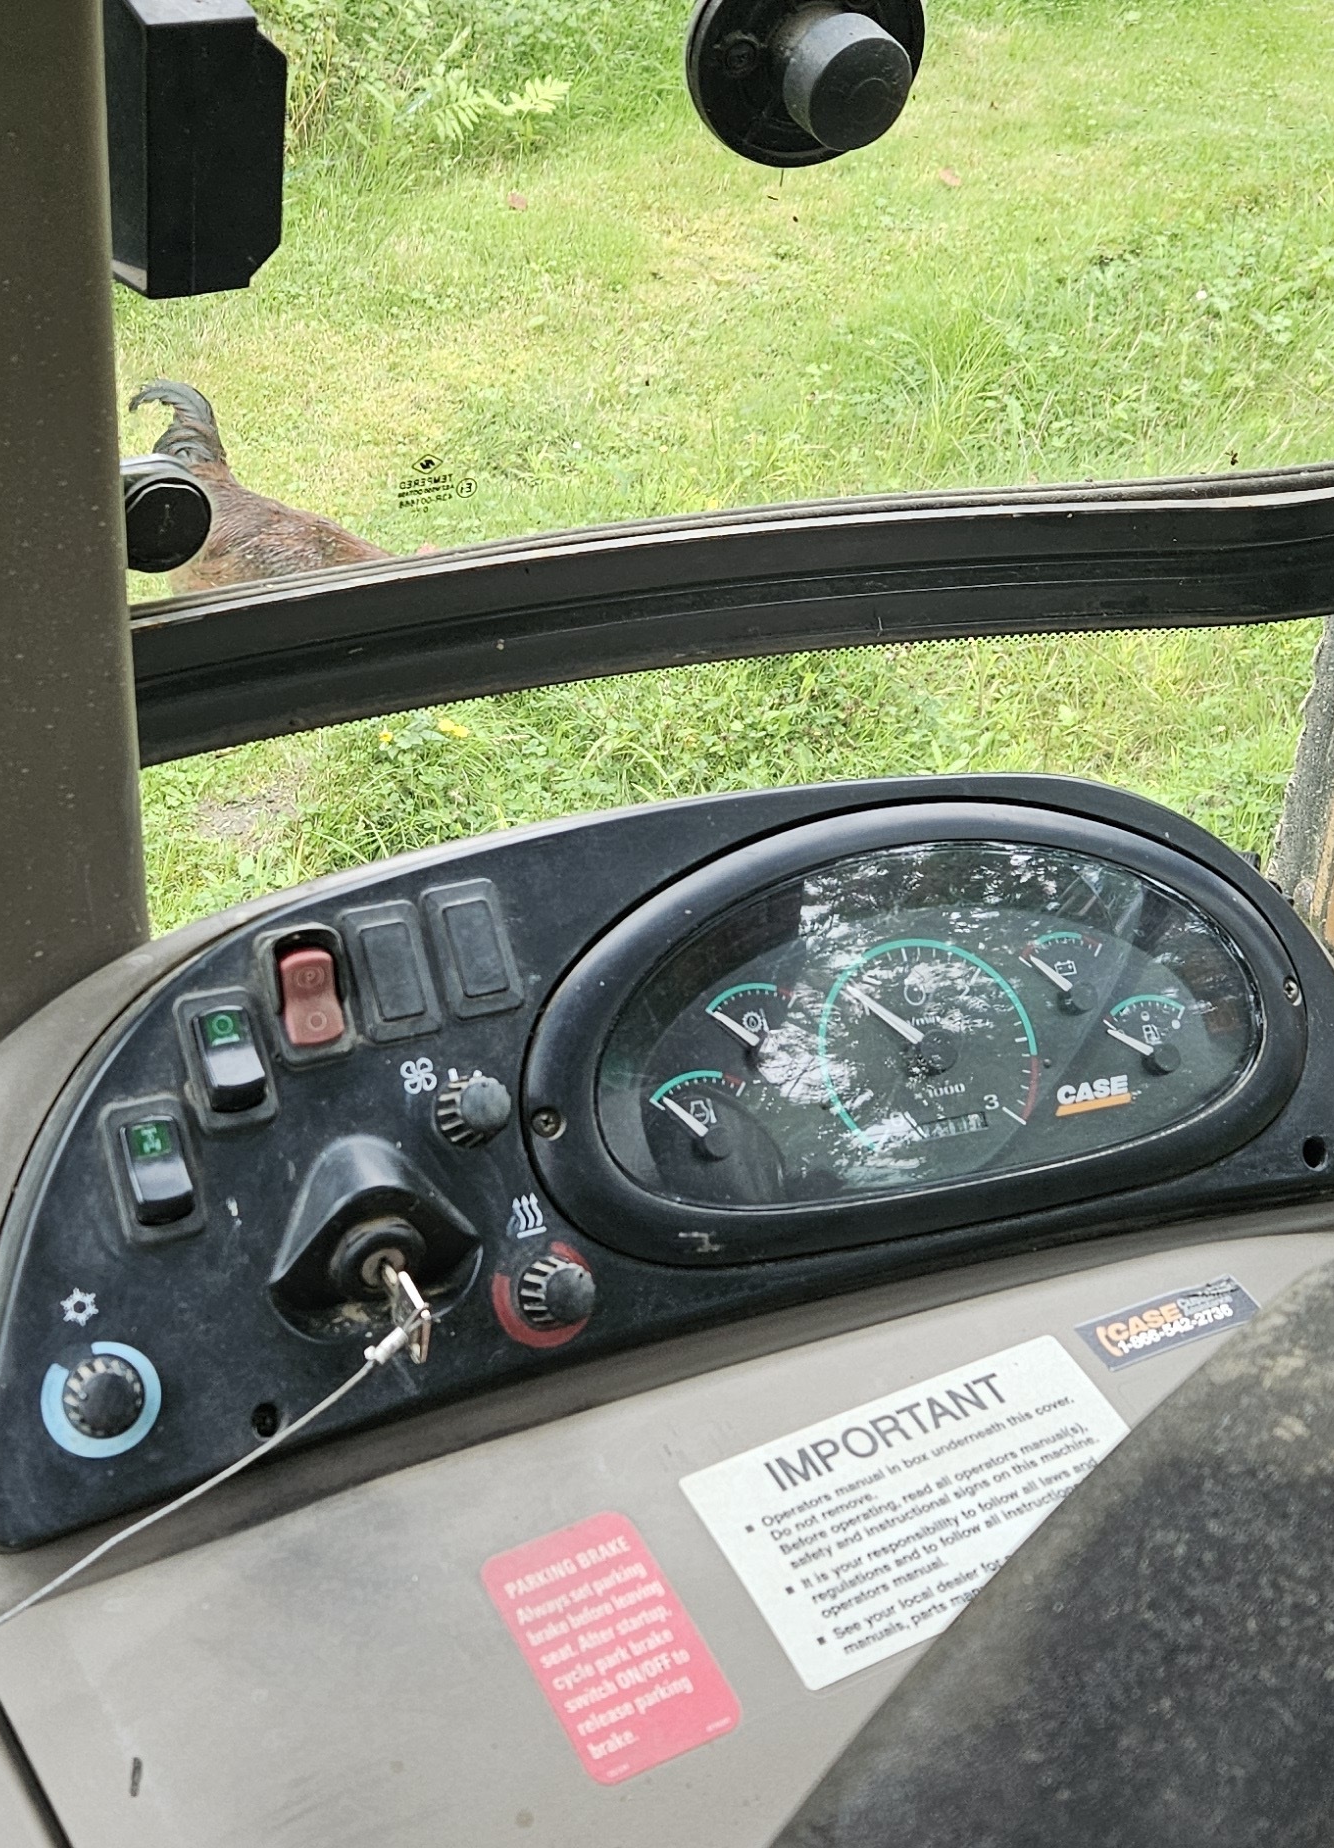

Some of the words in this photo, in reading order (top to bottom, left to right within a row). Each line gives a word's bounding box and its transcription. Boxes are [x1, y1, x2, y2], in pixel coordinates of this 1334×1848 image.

[926, 1083, 965, 1098] 1000
[983, 1093, 1000, 1110] 3
[1057, 1074, 1128, 1105] CASE
[1107, 1302, 1183, 1341] CASE
[762, 1493, 832, 1526] Operators
[835, 1469, 885, 1496] manual
[886, 1463, 901, 1475] in
[902, 1451, 929, 1469] box
[931, 1421, 1006, 1457] underneath
[1006, 1411, 1033, 1427] this
[1035, 1396, 1075, 1416] cover.
[764, 1372, 1006, 1491] IMPORTANT
[770, 1527, 792, 1541] Do
[795, 1515, 818, 1531] not
[822, 1493, 878, 1520] remove.
[779, 1529, 827, 1555] Before
[902, 1483, 932, 1503] read
[935, 1475, 953, 1490] all
[954, 1450, 1018, 1482] operators
[790, 1544, 833, 1569] safety
[836, 1531, 863, 1549] and
[866, 1493, 952, 1536] instructional
[953, 1479, 991, 1499] signs
[993, 1470, 1011, 1483] on
[1011, 1457, 1038, 1475] this
[1040, 1434, 1100, 1463] machine.
[801, 1576, 814, 1589] It
[815, 1572, 829, 1584] is
[832, 1556, 863, 1578] your
[867, 1515, 959, 1560] responsibility
[961, 1507, 976, 1520] to
[978, 1490, 1019, 1512] follow
[1021, 1479, 1039, 1495] all
[1039, 1469, 1071, 1487] laws
[1072, 1455, 1098, 1474] and
[503, 1558, 577, 1599] PARKING
[575, 1535, 631, 1570] BRAKE
[812, 1564, 891, 1604] regulations
[894, 1549, 921, 1567] and
[922, 1543, 938, 1555] to
[940, 1524, 980, 1547] follow
[984, 1514, 1001, 1529] all
[822, 1582, 890, 1618] operators
[892, 1556, 949, 1587] manual.
[516, 1593, 572, 1626] Always
[568, 1582, 594, 1603] set
[591, 1562, 648, 1597] parking
[526, 1620, 571, 1646] brake
[566, 1601, 614, 1629] before
[609, 1580, 665, 1610] leaving
[832, 1621, 861, 1639] See
[864, 1605, 896, 1628] your
[898, 1586, 935, 1609] local
[937, 1568, 978, 1593] dealer
[552, 1662, 596, 1690] cycle
[594, 1645, 632, 1676] park
[628, 1629, 674, 1656] brake
[577, 1627, 616, 1652] After
[843, 1620, 911, 1655] manuals,
[911, 1601, 947, 1627] parts
[564, 1679, 618, 1713] switch
[615, 1652, 671, 1689] ON/OFF
[670, 1648, 690, 1665] to
[577, 1701, 635, 1736] release
[633, 1676, 694, 1714] parking
[586, 1730, 640, 1760] brake.
